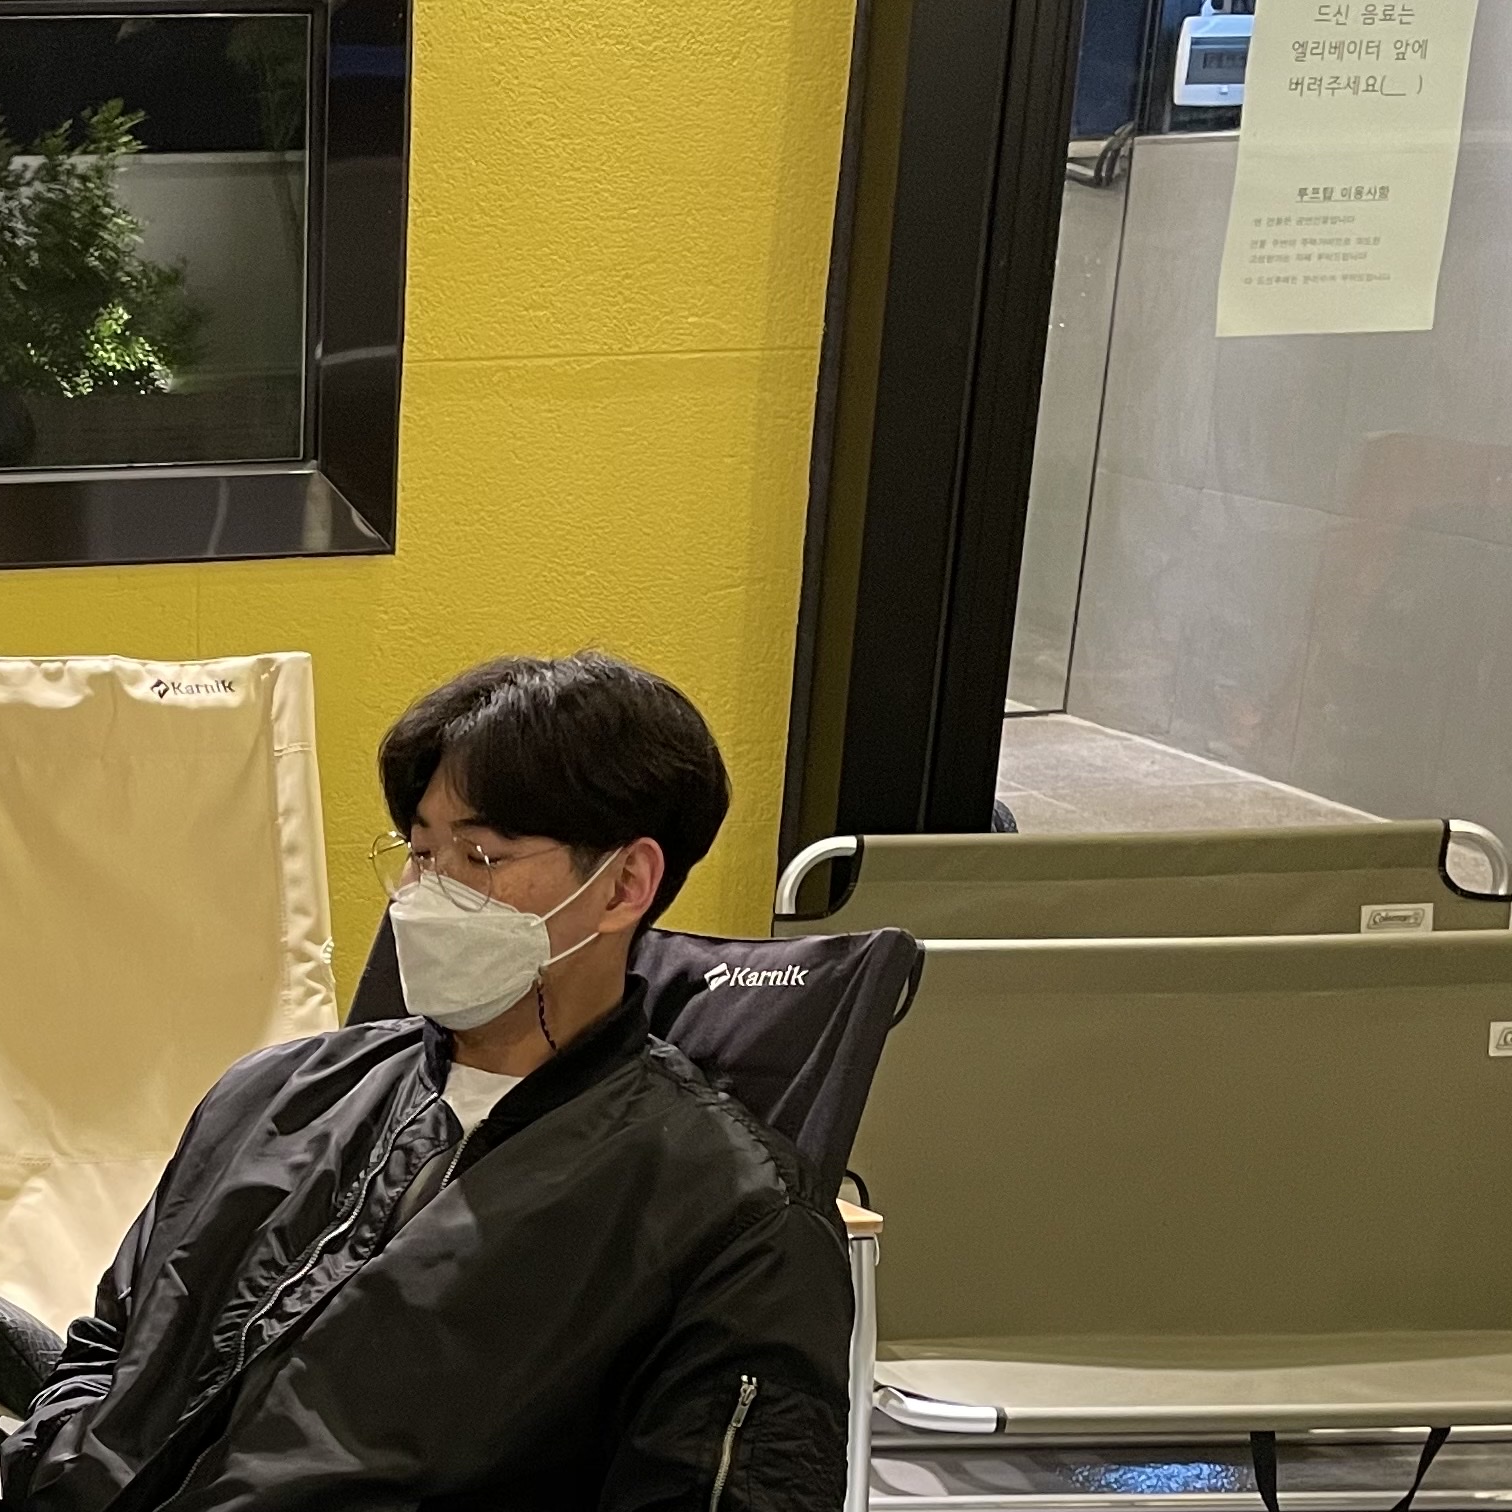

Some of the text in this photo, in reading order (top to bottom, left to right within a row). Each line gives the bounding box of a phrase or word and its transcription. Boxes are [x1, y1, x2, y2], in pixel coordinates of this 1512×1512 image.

[1314, 3, 1415, 26] 드신 음료는
[1291, 38, 1428, 62] 엘리베이터 앞에
[1340, 185, 1390, 200] 이용사항
[171, 679, 236, 696] Karnik
[729, 964, 809, 987] Karnik
